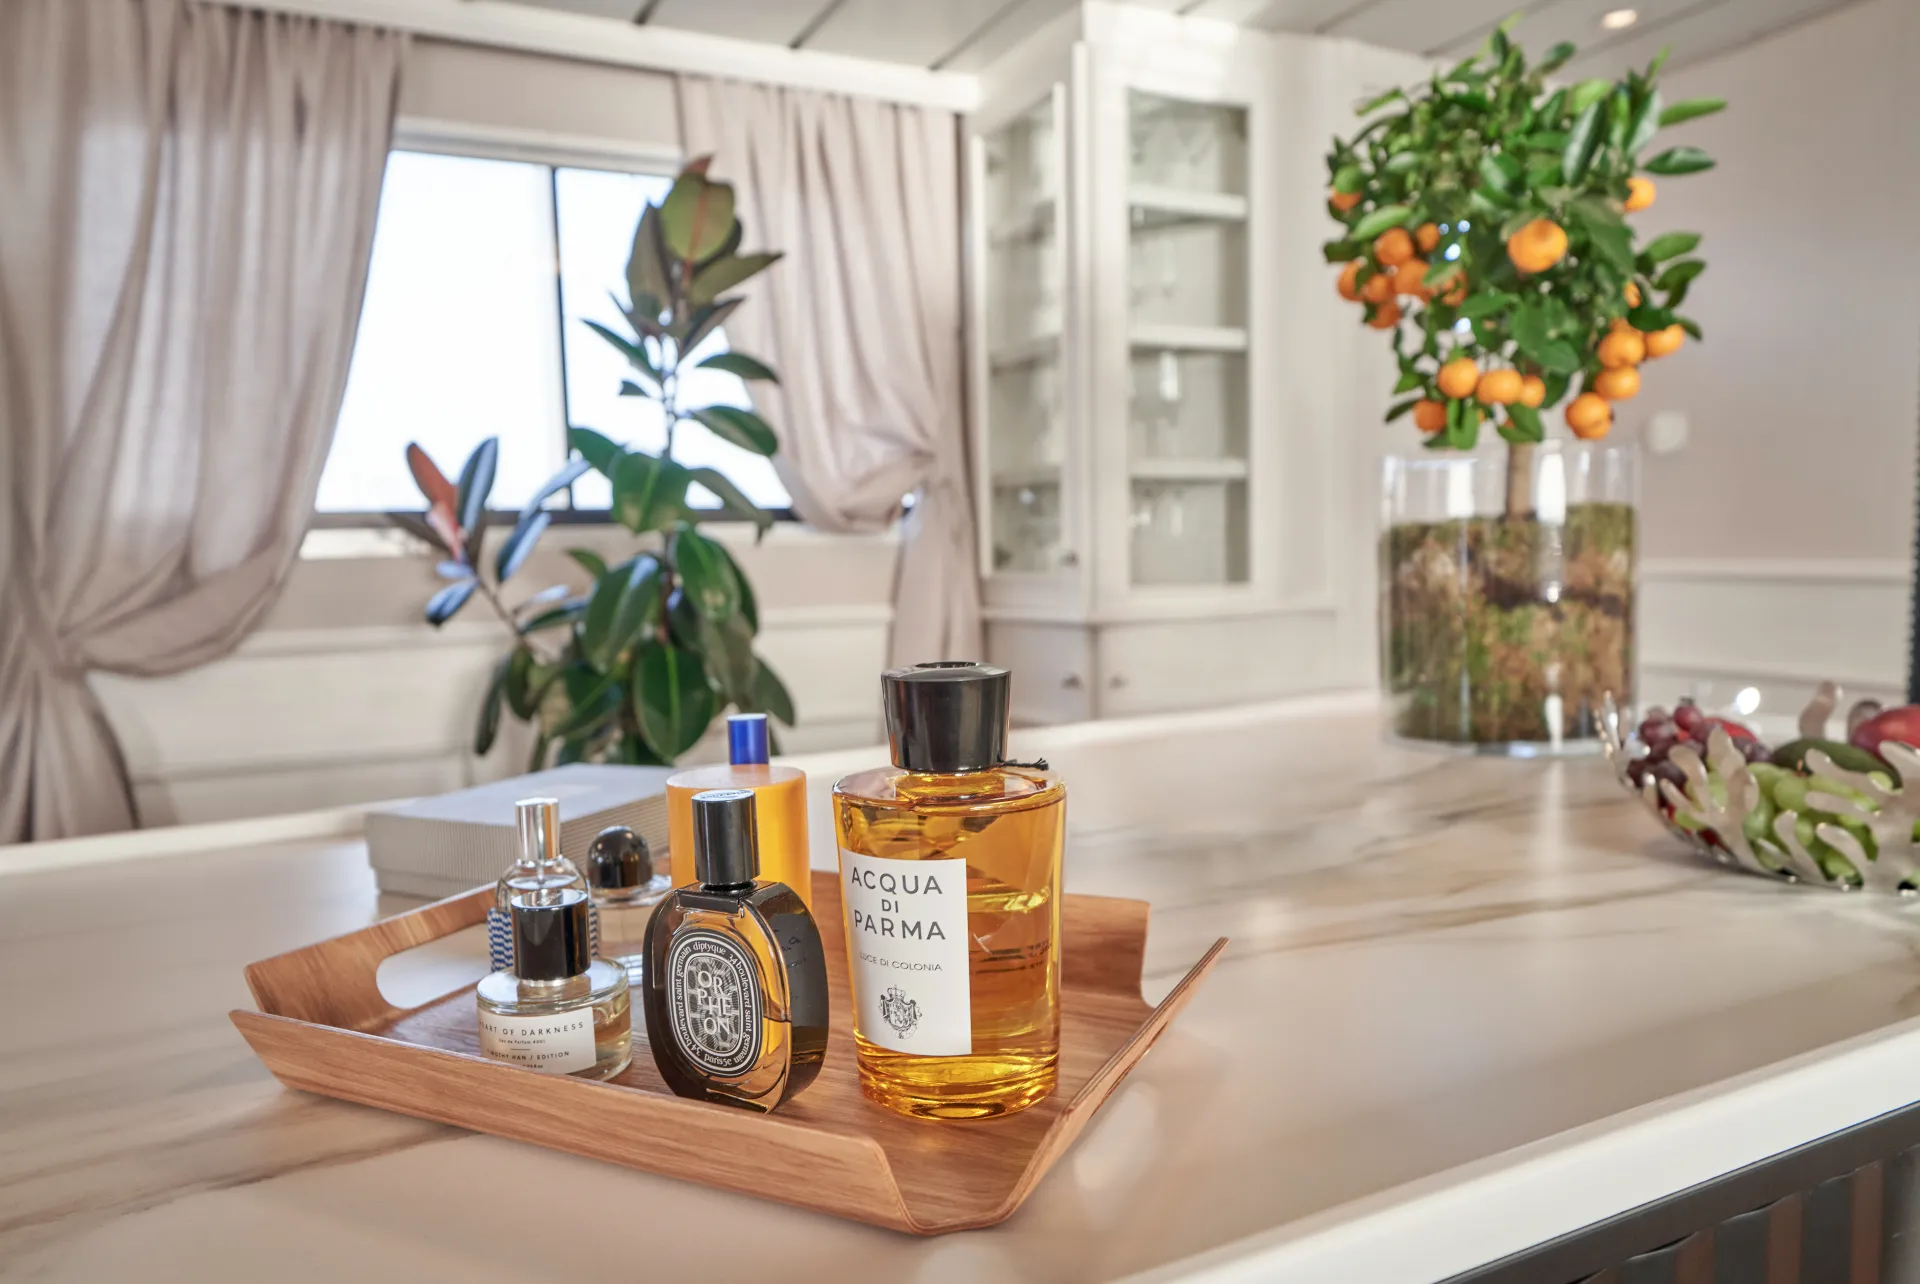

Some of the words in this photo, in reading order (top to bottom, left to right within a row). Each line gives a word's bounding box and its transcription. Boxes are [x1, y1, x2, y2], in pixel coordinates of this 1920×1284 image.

[851, 867, 943, 895] ACQUA
[881, 899, 899, 913] DI
[854, 909, 946, 940] PARMA
[693, 942, 726, 955] diptyque
[676, 946, 692, 978] germain
[880, 958, 889, 967] DI
[891, 961, 943, 971] COLONIA
[675, 979, 683, 1001] saint
[736, 962, 752, 1008] boulevard
[521, 1022, 584, 1036] DARKNESS
[676, 1002, 692, 1047] boulevard
[744, 1009, 753, 1032] saint
[537, 1051, 569, 1060] EDITION
[733, 1032, 751, 1063] germain
